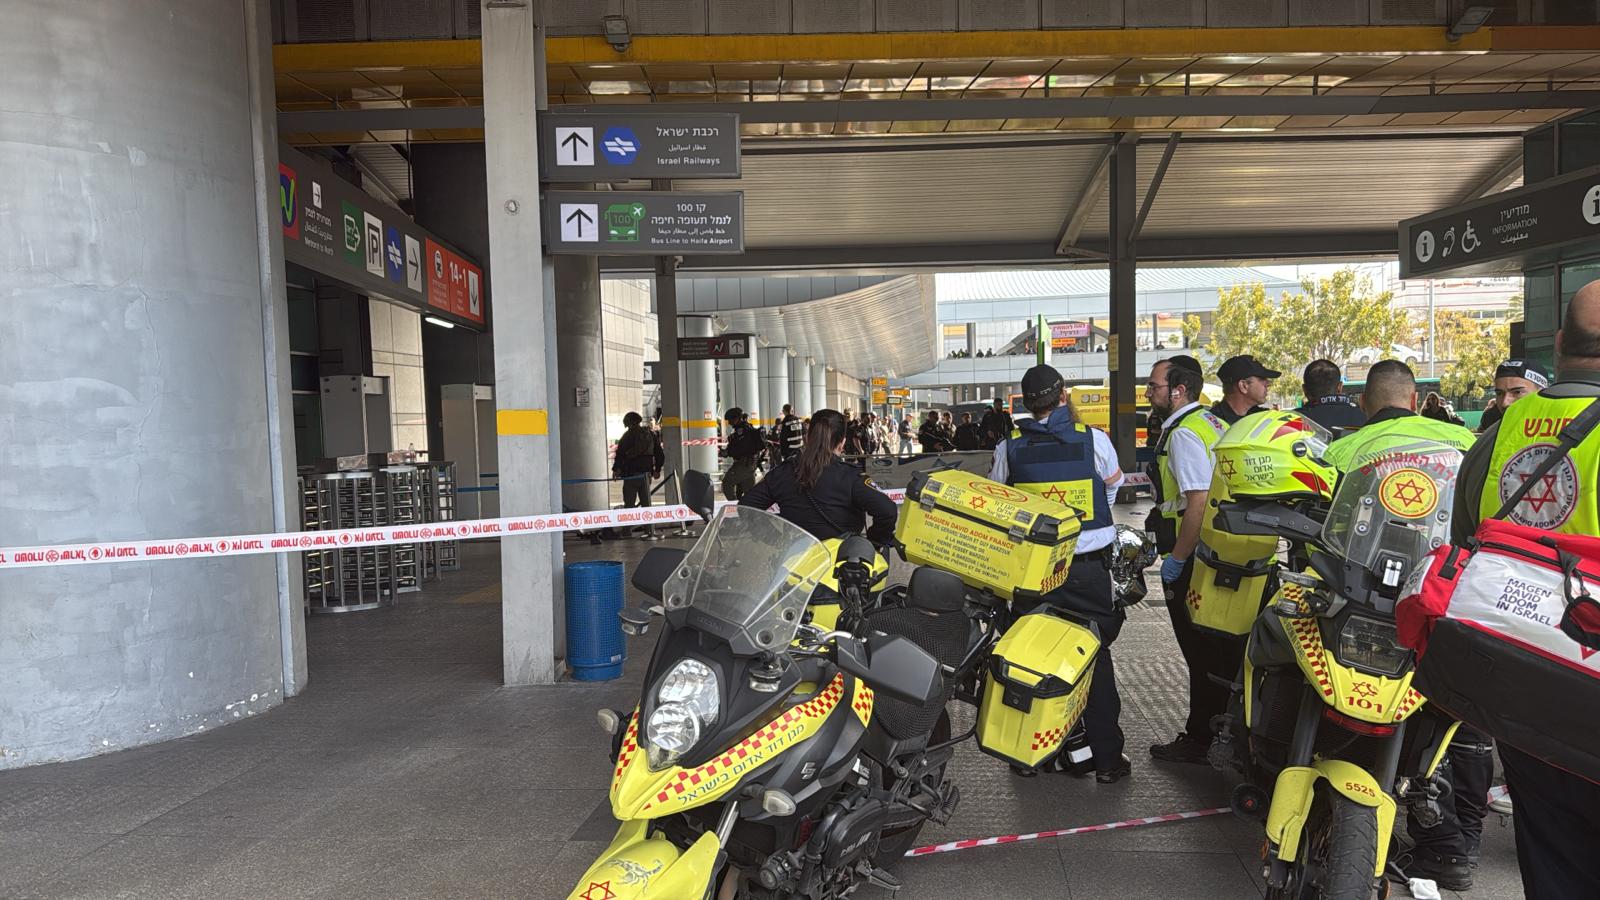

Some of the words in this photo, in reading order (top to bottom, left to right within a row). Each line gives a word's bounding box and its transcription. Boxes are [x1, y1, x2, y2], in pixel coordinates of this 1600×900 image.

[656, 126, 688, 136] ישראל
[692, 128, 719, 136] רכבת
[684, 157, 720, 166] Railways
[696, 204, 706, 213] קו
[1500, 205, 1529, 222] מודיעין
[614, 216, 630, 224] 100
[651, 216, 674, 225] חיפה
[678, 216, 707, 225] תעופה
[710, 216, 732, 224] לנמל
[1492, 217, 1537, 234] INFORMATION
[450, 261, 466, 288] 14-1
[1254, 464, 1273, 473] אדום
[1259, 456, 1271, 466] מגן
[1244, 472, 1274, 481] בישראל
[1514, 512, 1532, 525] DAVID
[1535, 518, 1555, 528] ADOM
[1560, 494, 1572, 516] ISRAEL
[925, 513, 950, 526] MAGUEN
[951, 523, 969, 533] DAVID
[970, 530, 988, 540] ADOM
[989, 537, 1014, 550] FRANCE
[14, 552, 44, 563] משטרת
[61, 550, 86, 560] ישראל
[105, 548, 117, 557] אין
[117, 547, 136, 556] מעבר
[146, 546, 175, 556] משטרת
[190, 543, 214, 553] ישראל
[232, 541, 243, 550] אין
[244, 540, 263, 549] מעבר
[271, 539, 298, 548] משטרת
[314, 536, 336, 545] ישראל
[354, 533, 364, 542] אין
[365, 532, 384, 542] מעבר
[392, 531, 419, 540] משטרת
[433, 528, 456, 537] ישראל
[472, 526, 483, 534] אין
[483, 524, 500, 532] מעבר
[1504, 586, 1540, 602] DAVID
[1508, 578, 1552, 598] MAGEN
[1499, 594, 1537, 611] ADOM
[1496, 601, 1510, 611] IN
[1512, 606, 1551, 626] ISRAEL
[1346, 696, 1383, 713] 101
[787, 724, 805, 742] מגן
[765, 738, 784, 752] דוד
[733, 751, 763, 775] אדום
[678, 773, 729, 805] בישראל
[1346, 782, 1375, 798] 5525
